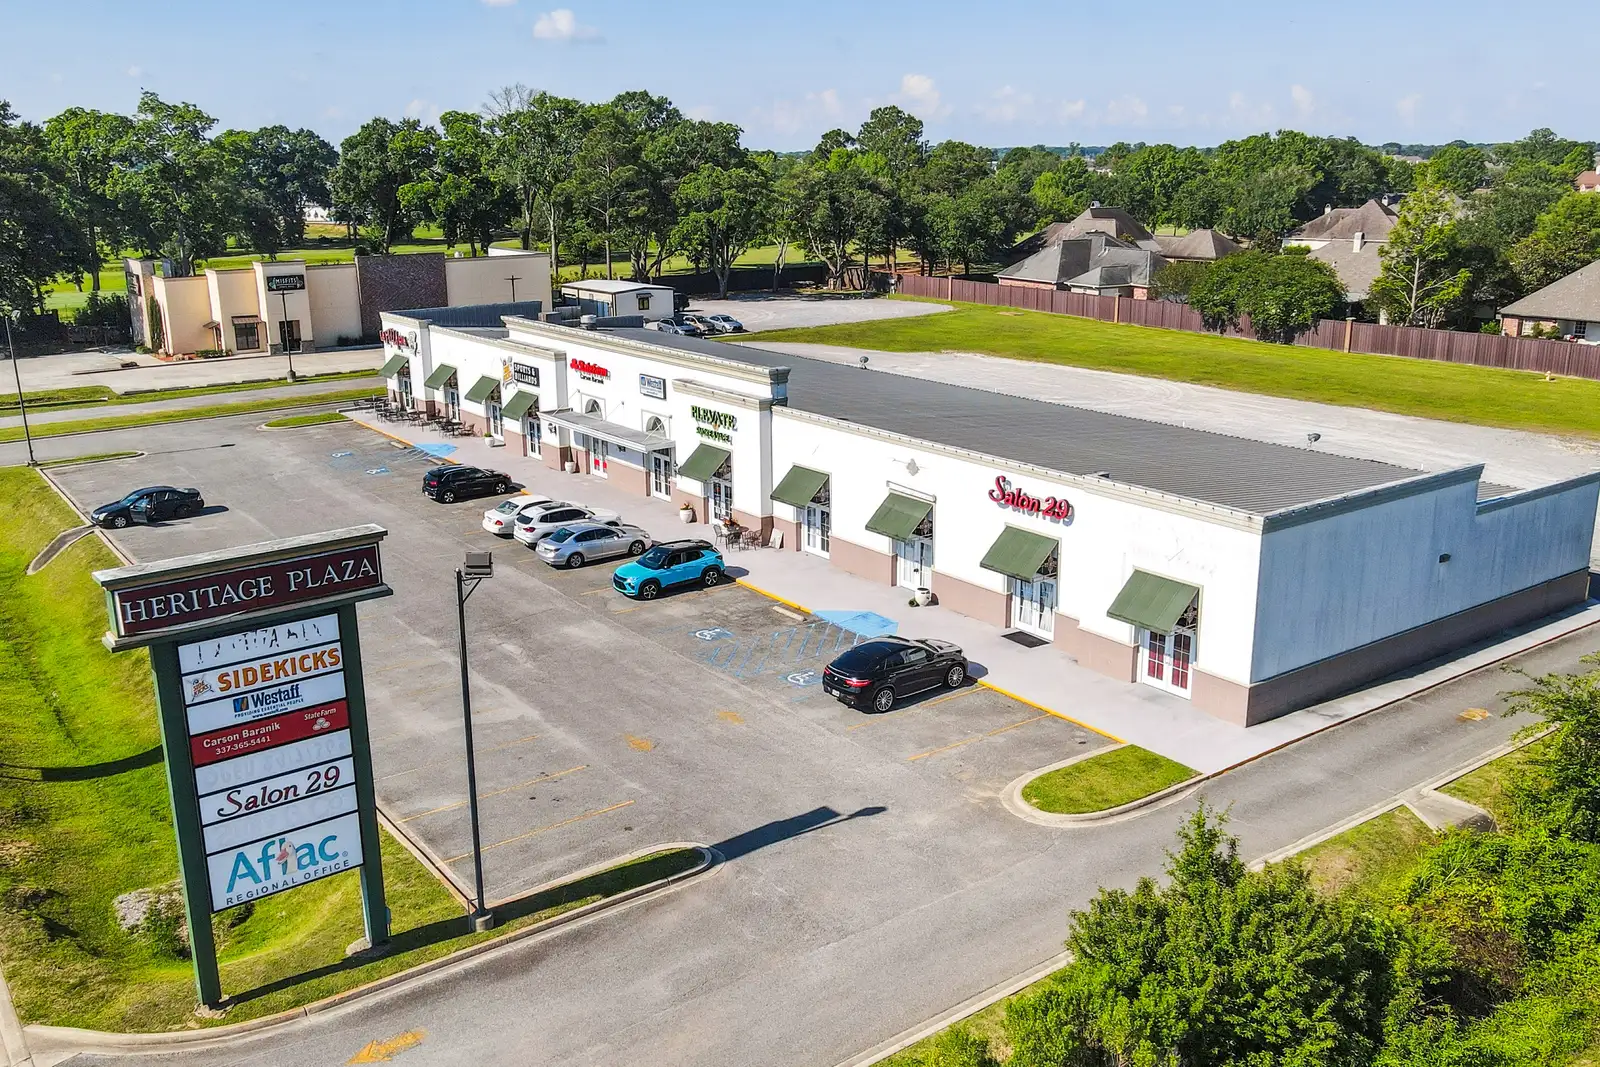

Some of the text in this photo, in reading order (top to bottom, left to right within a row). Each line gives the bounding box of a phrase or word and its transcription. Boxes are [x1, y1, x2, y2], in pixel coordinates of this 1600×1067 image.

[514, 363, 531, 375] SPORTS
[514, 372, 538, 385] BILLIARDS
[690, 405, 736, 429] ELEVATE
[988, 475, 1070, 520] Salon 29
[121, 557, 377, 624] HERITAGE PLAZA
[217, 647, 341, 692] SIDEKICKS
[234, 698, 304, 719] PROVIDING ESSENTIAL PEOPLE
[251, 684, 301, 708] Westaff
[203, 722, 281, 748] Carson Baranik
[215, 735, 271, 755] 337-365-5441
[217, 765, 341, 817] Salon 29
[226, 834, 340, 894] Aflac
[226, 859, 350, 906] REGIONAL OFFICE
